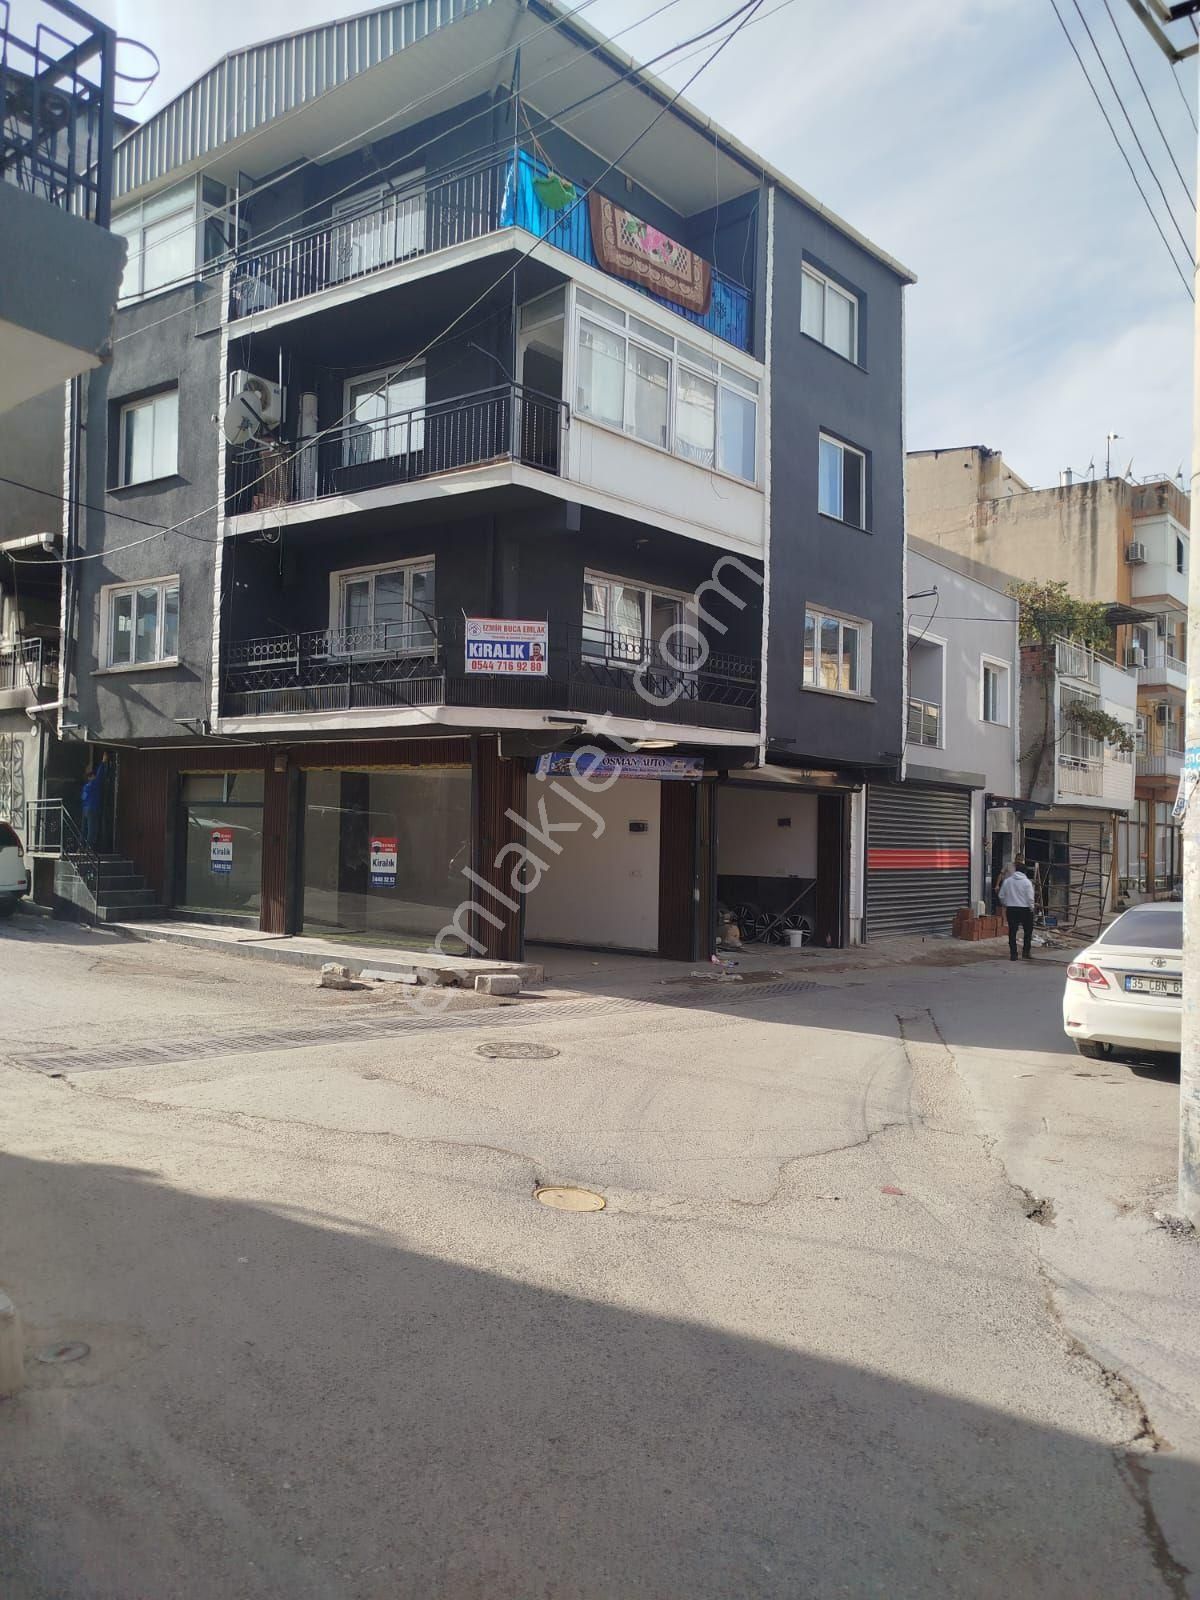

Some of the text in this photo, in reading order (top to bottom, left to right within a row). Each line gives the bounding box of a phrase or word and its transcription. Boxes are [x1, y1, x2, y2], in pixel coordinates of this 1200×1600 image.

[471, 660, 494, 670] 0544
[497, 661, 514, 671] 716
[516, 662, 528, 671] 92
[602, 756, 637, 767] OSMAN
[1131, 976, 1183, 993] 35 CBN 6
